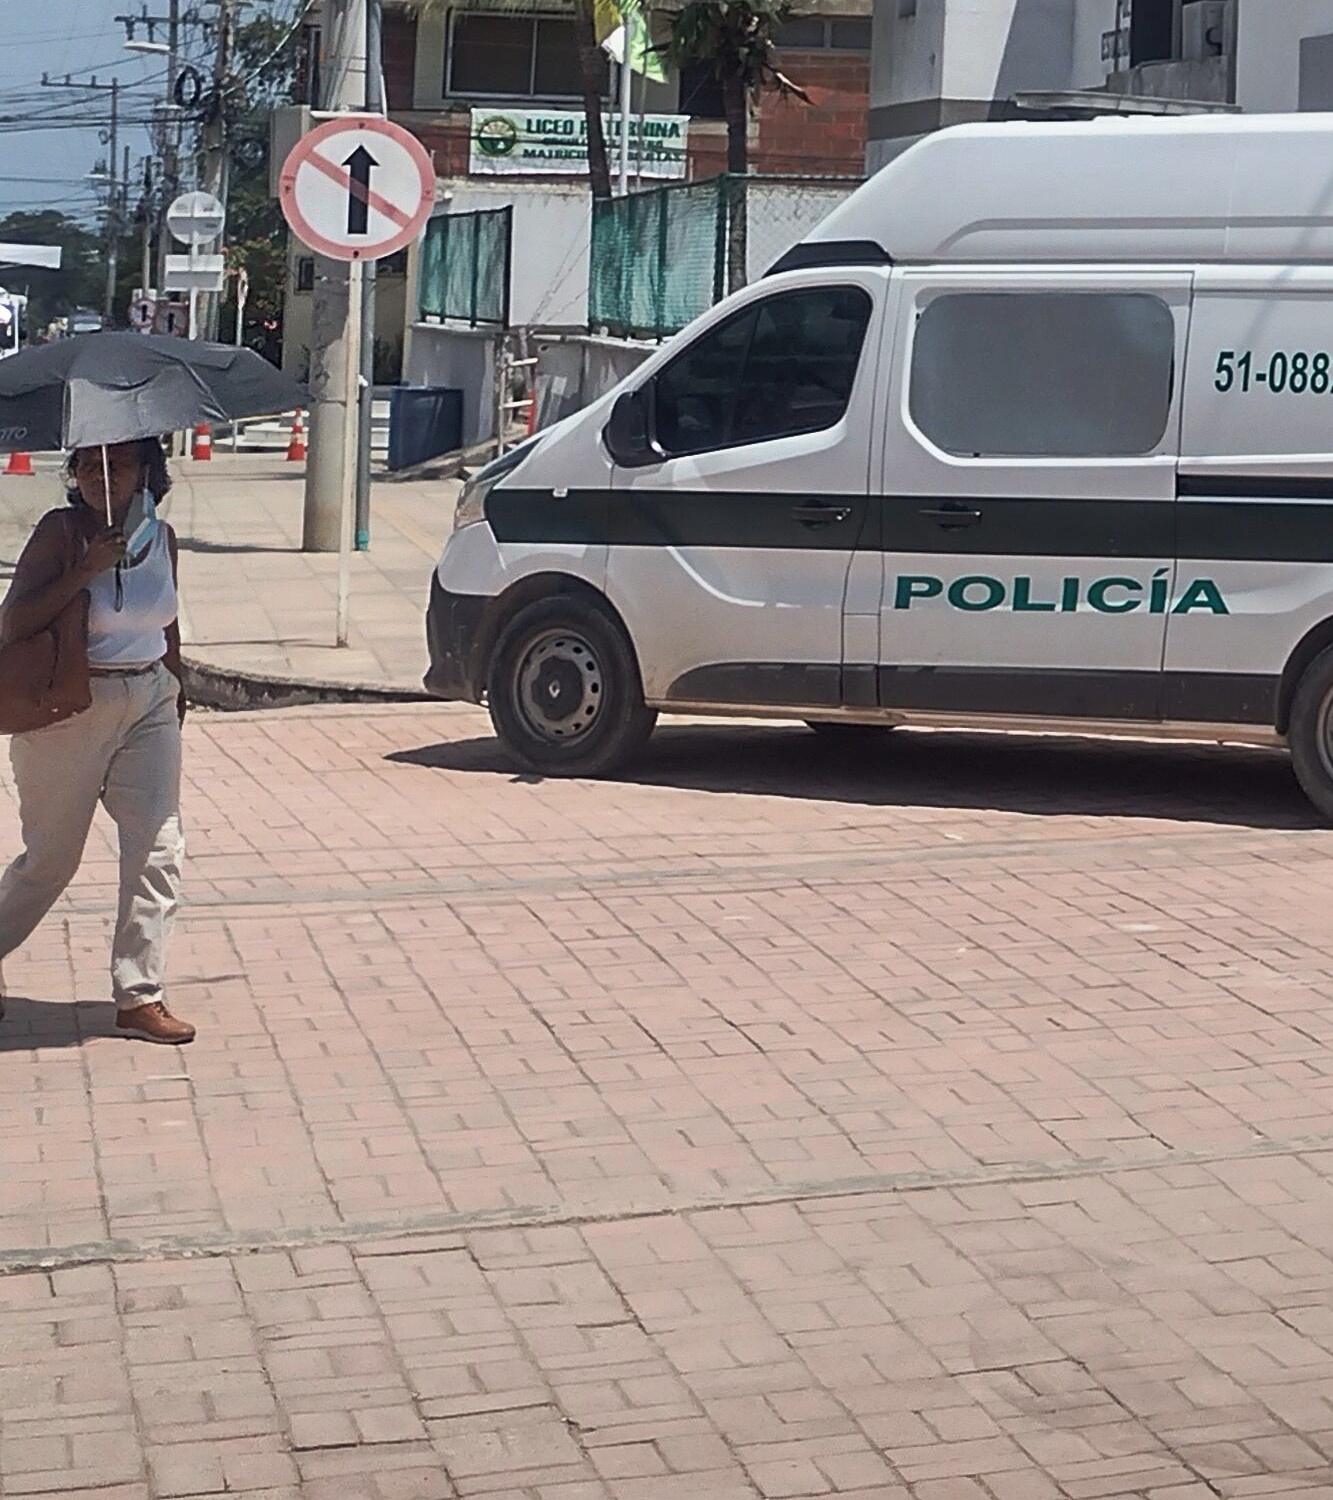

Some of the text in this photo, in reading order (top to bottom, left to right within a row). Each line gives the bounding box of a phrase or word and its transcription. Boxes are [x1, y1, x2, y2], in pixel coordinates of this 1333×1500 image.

[526, 118, 681, 138] LICEO PTERNINA
[893, 567, 1230, 614] POLICÍA
